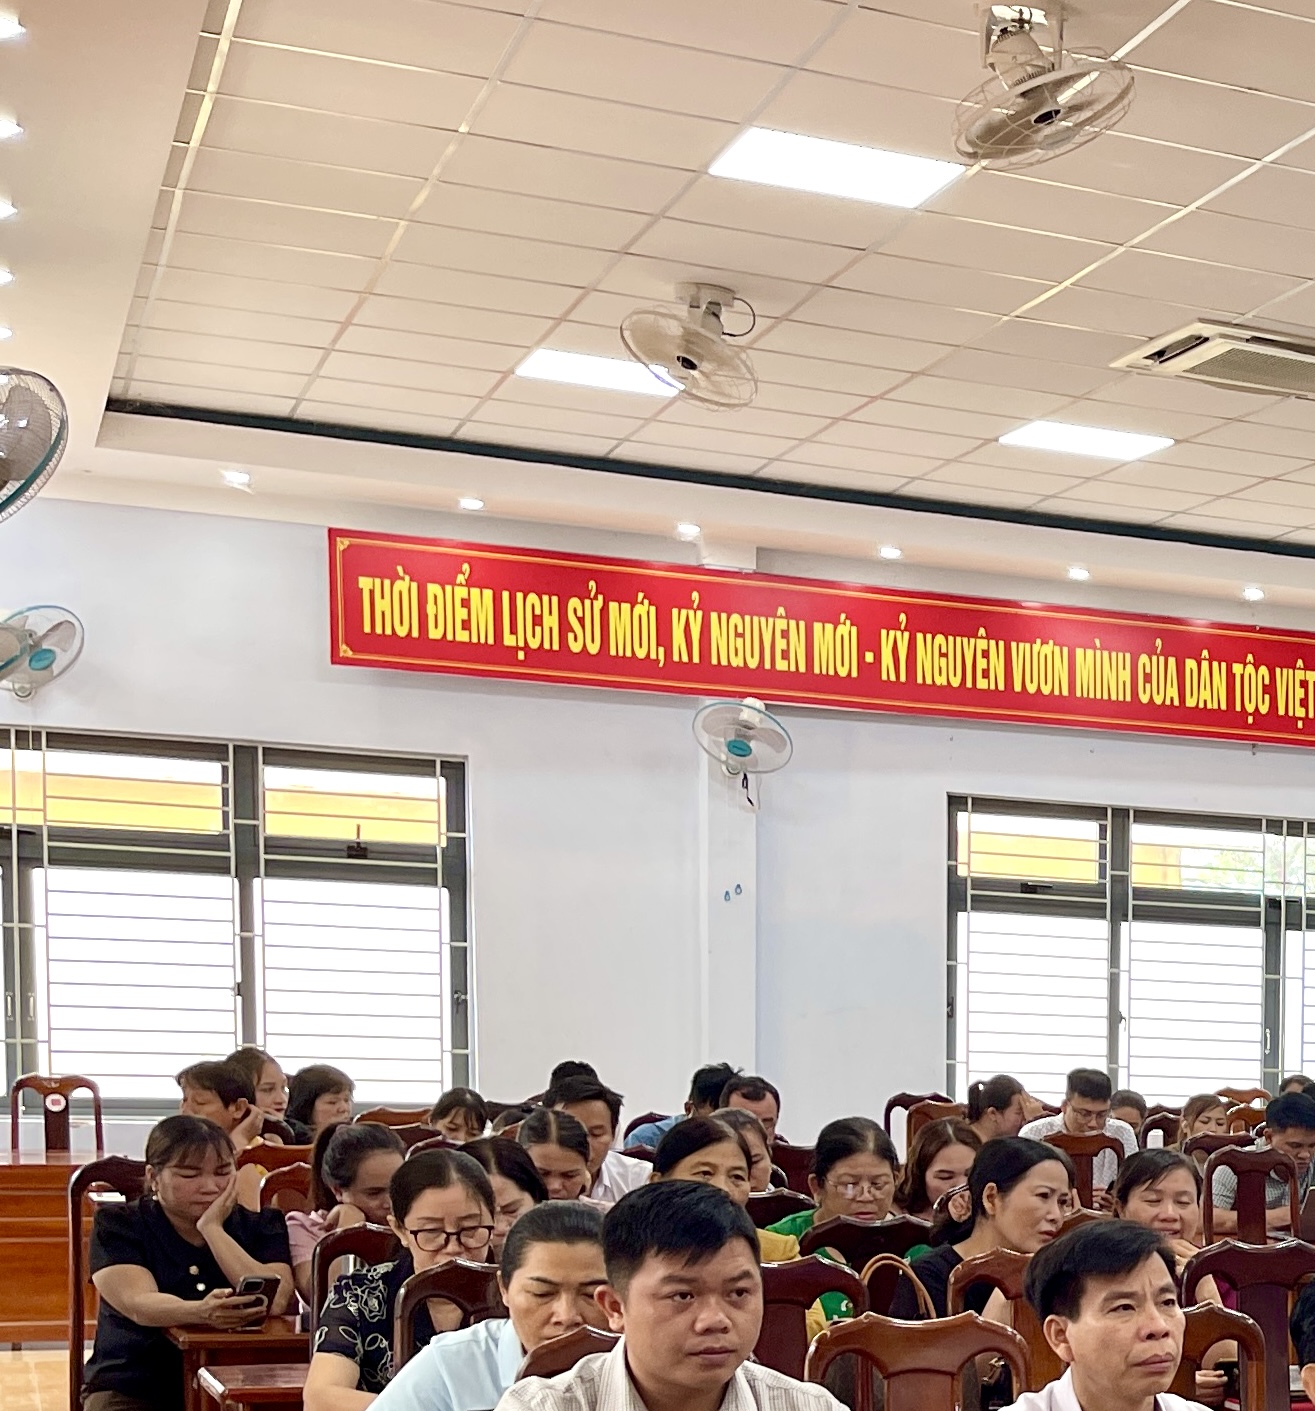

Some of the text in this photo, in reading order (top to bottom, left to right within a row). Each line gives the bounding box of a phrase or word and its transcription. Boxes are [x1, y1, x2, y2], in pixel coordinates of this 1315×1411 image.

[358, 566, 419, 637] THỜI
[426, 563, 494, 644] ĐIỂM
[502, 591, 559, 660] LỊCH
[567, 581, 603, 654] SỬ
[609, 592, 665, 666] MỚI,
[672, 591, 703, 663] KỶ
[710, 607, 806, 672] NGUYÊN
[813, 613, 858, 677] MỚI
[865, 651, 874, 663] -
[880, 613, 909, 682] KỶ
[916, 628, 1005, 690] NGUYÊN
[1011, 639, 1069, 696] VƯƠN
[1075, 640, 1131, 701] MÌNH
[1138, 640, 1179, 705] CỦA
[1185, 650, 1227, 710] DÂN
[1232, 654, 1270, 723] TỘC
